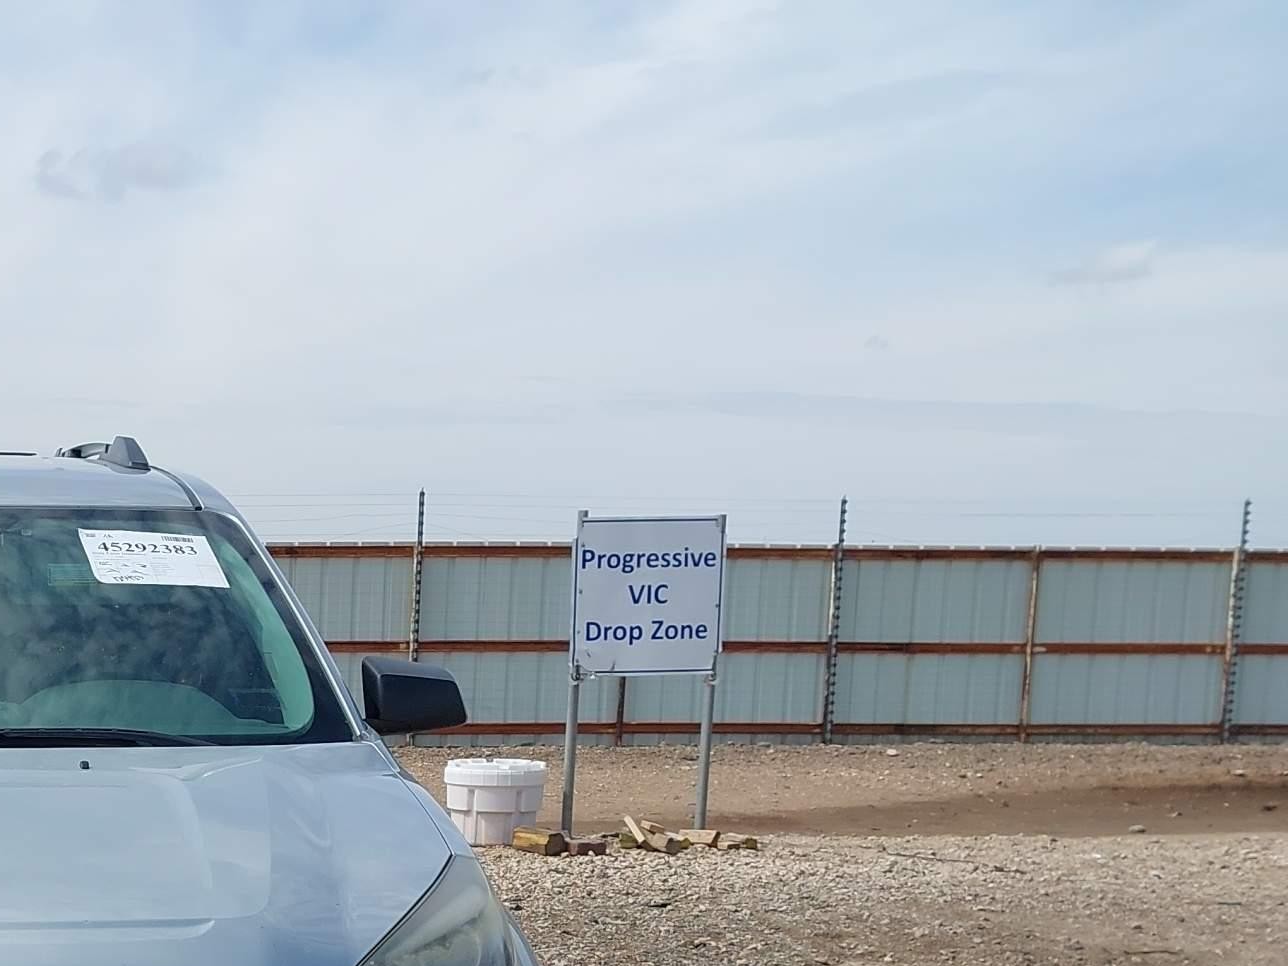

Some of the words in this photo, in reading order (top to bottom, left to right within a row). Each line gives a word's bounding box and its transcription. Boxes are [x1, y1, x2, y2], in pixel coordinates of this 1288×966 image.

[98, 541, 198, 556] 45292383
[581, 547, 717, 574] Progressive
[628, 584, 669, 604] VIC
[585, 621, 643, 645] Drop
[651, 620, 708, 640] Zone
